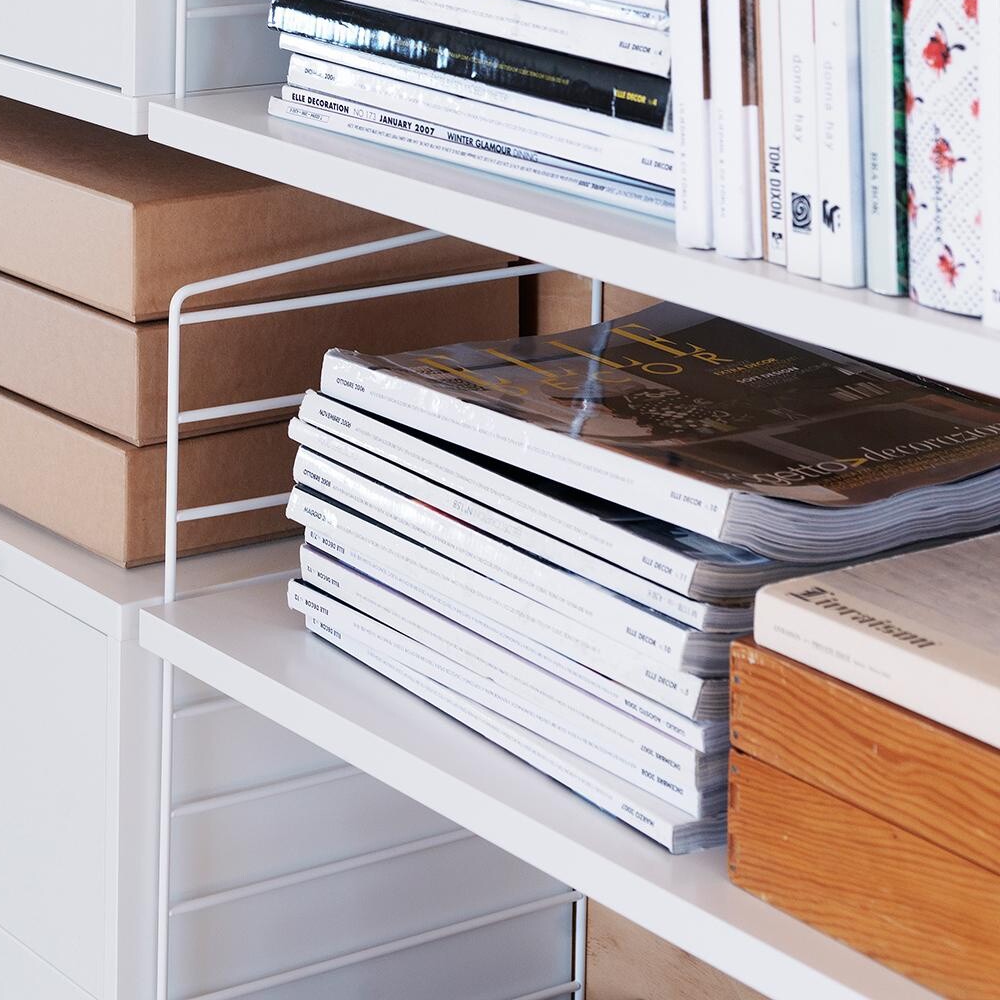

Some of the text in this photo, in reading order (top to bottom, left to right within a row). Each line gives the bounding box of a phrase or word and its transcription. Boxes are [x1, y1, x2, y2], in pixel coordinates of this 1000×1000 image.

[632, 43, 651, 53] DECOR
[626, 91, 647, 105] DECOR
[291, 92, 305, 104] ELLE
[307, 95, 350, 115] DECORATION
[379, 114, 413, 130] JANUARY
[414, 122, 435, 136] 2007
[447, 131, 475, 147] WINTER
[475, 137, 512, 157] GLAMOUR
[653, 159, 673, 172] DECOR
[769, 145, 782, 221] TOM DIXON
[318, 408, 342, 424] NOVEMBRE
[682, 494, 703, 507] DECOR
[653, 561, 673, 576] DECOR
[304, 599, 320, 612] DECOR
[638, 630, 657, 647] DECOR
[657, 674, 678, 690] DECOR
